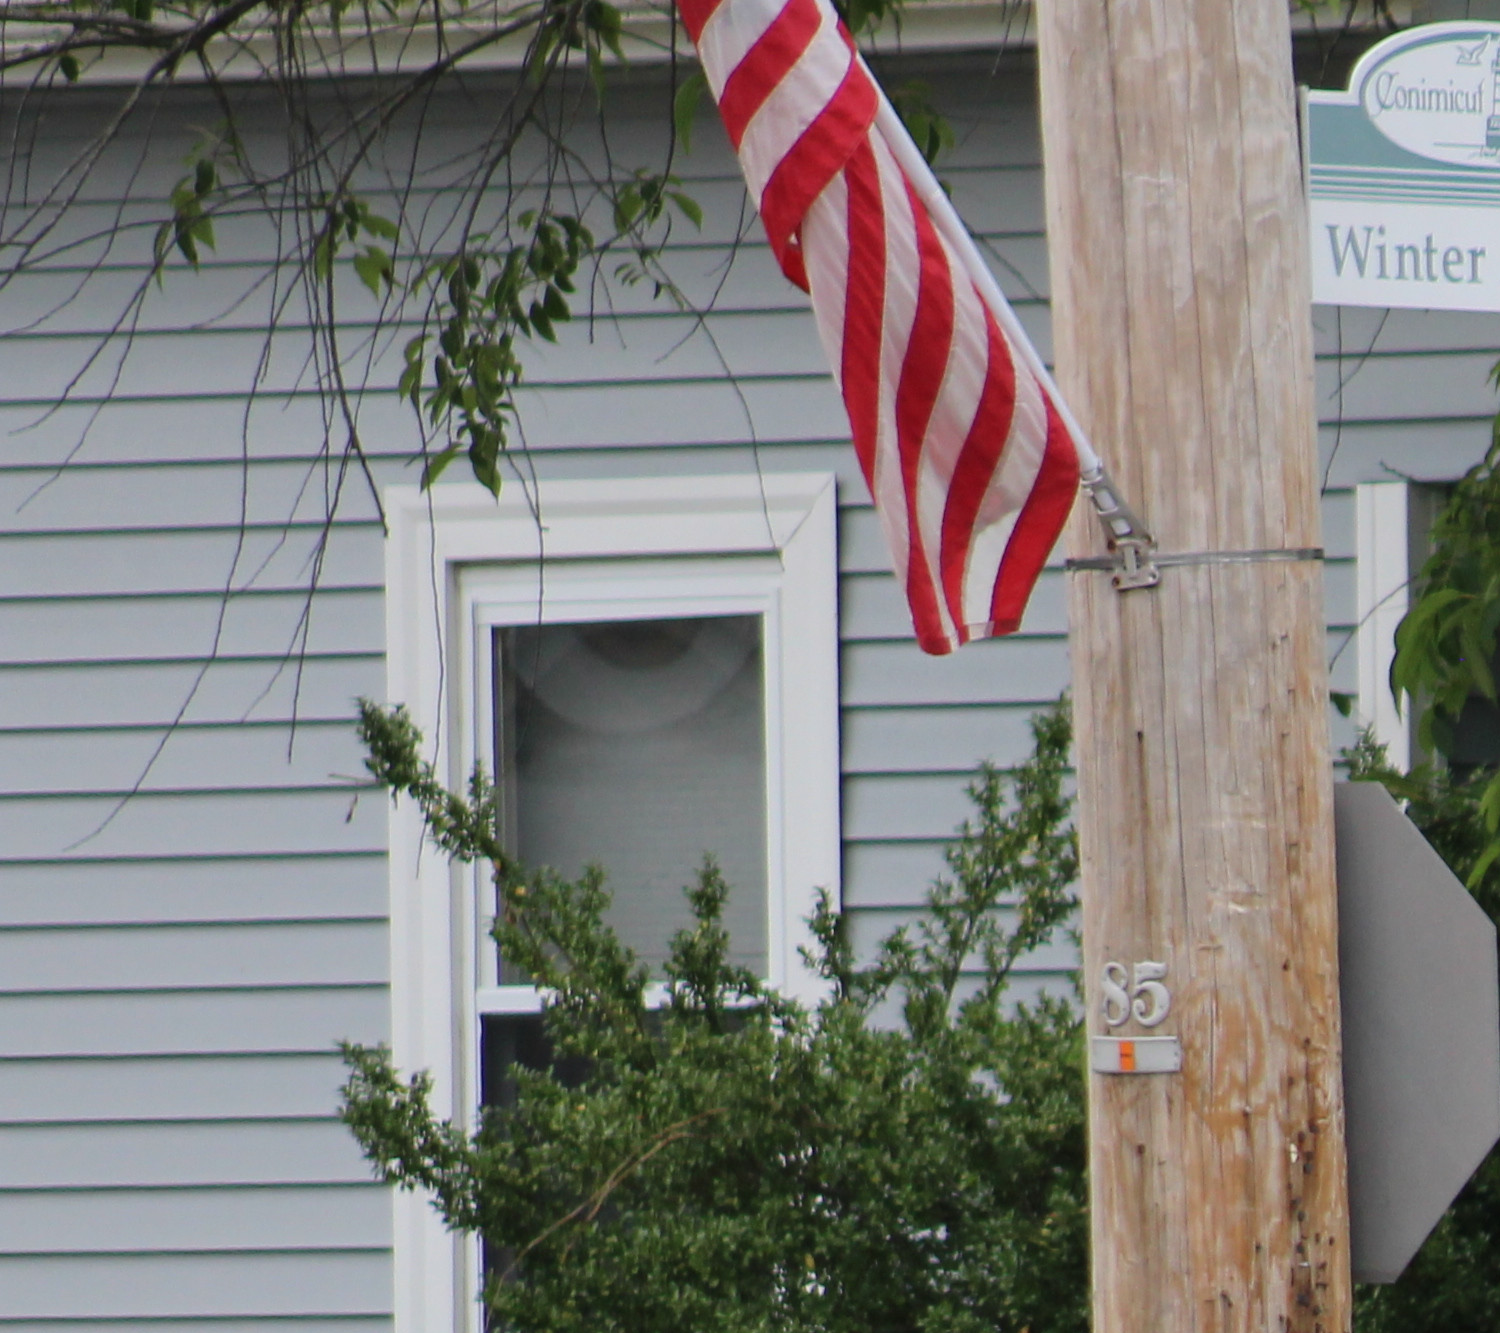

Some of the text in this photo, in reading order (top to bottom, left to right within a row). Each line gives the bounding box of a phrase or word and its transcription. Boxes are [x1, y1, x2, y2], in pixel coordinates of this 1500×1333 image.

[1375, 71, 1485, 117] Conimicut
[1325, 224, 1486, 284] Winter
[1102, 960, 1171, 1027] 85
